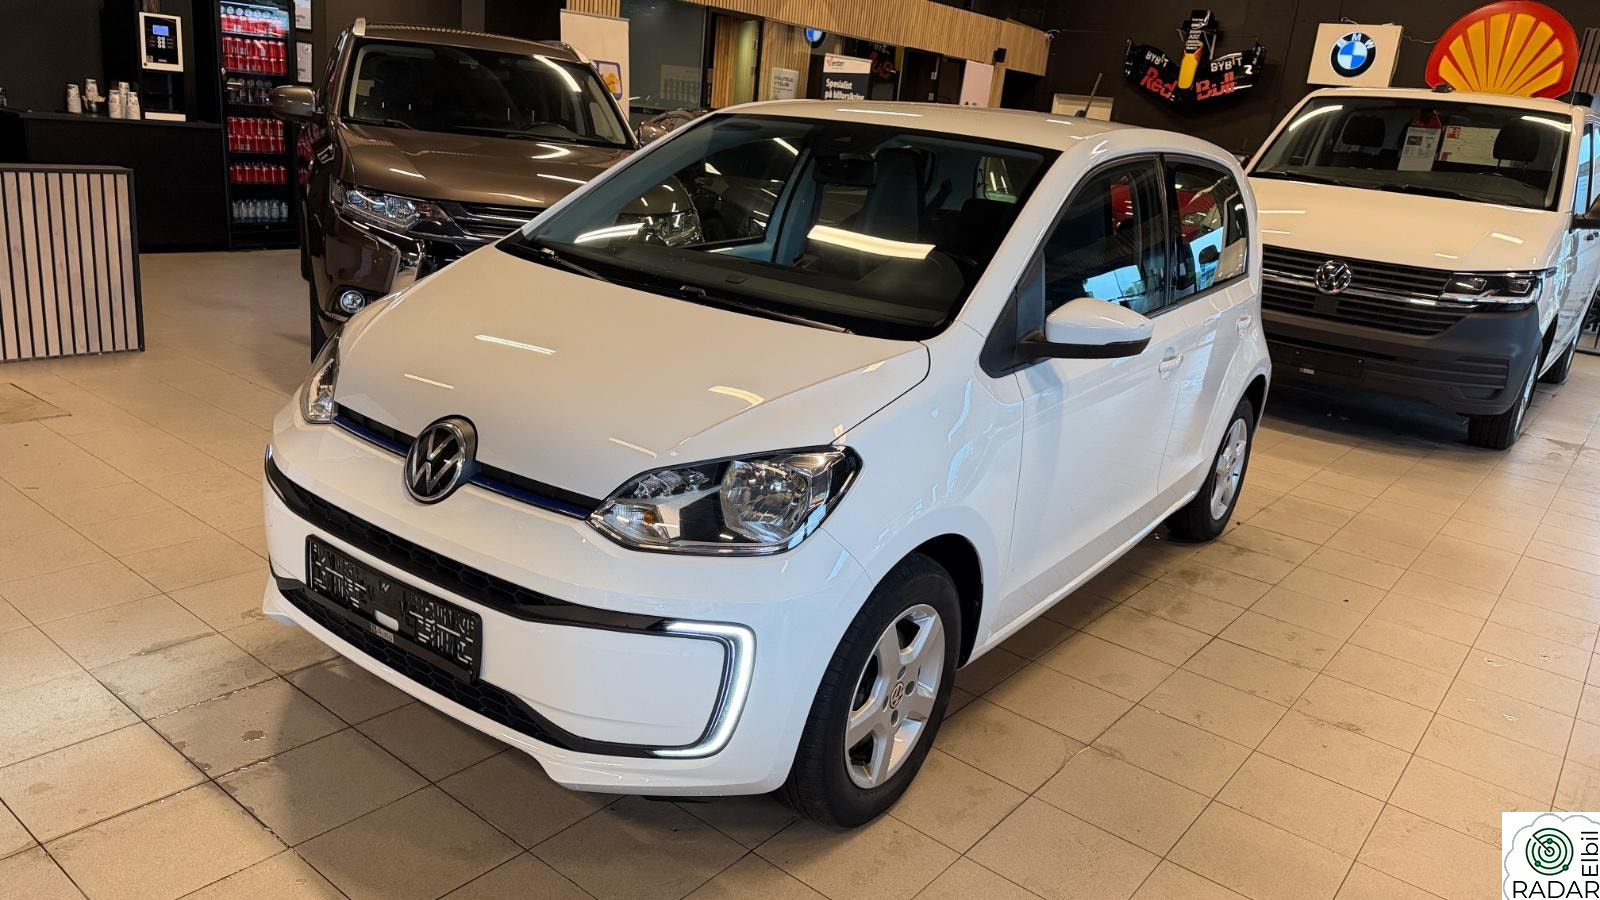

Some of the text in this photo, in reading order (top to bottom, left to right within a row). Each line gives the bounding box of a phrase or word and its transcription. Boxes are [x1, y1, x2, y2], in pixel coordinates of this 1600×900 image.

[1337, 33, 1375, 50] BMW
[1145, 50, 1169, 68] BYBIT
[1210, 56, 1242, 73] BYBIT
[826, 78, 852, 90] Spesialist
[1140, 66, 1236, 100] Red Bull
